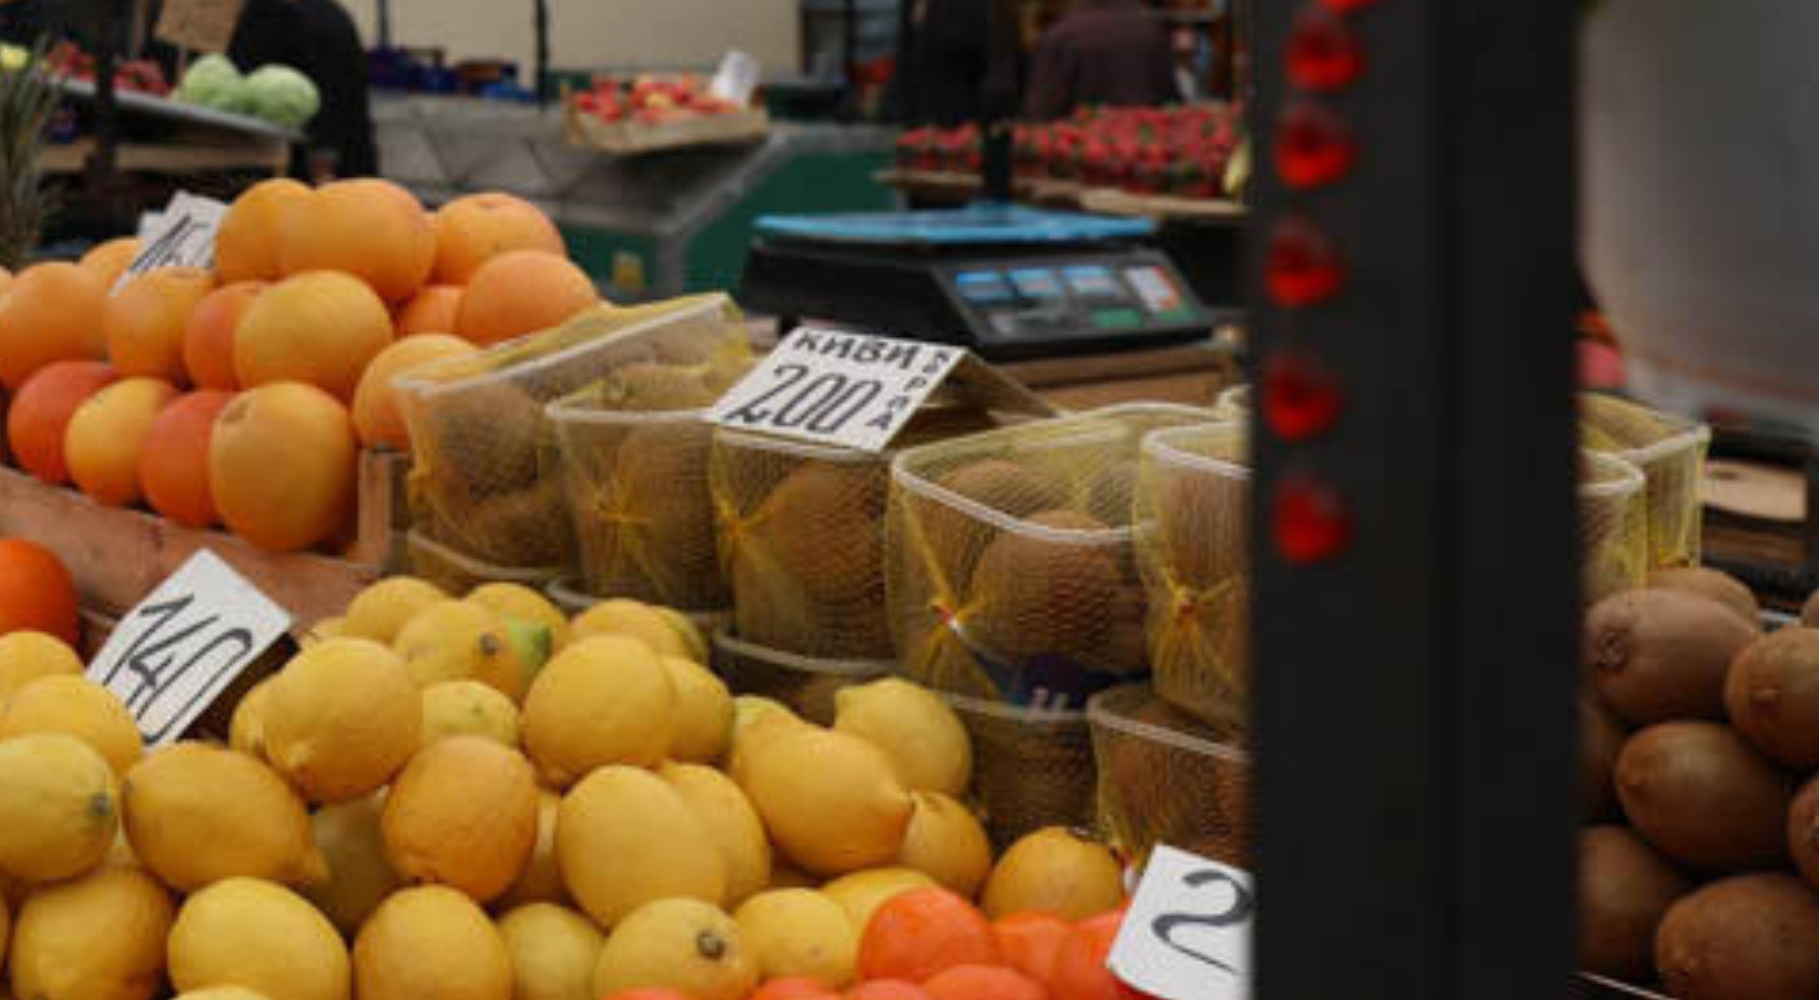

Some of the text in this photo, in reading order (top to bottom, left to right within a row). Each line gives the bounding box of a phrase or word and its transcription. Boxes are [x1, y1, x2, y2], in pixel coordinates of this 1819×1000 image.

[791, 329, 921, 370] КИВИ
[723, 364, 883, 434] 200
[101, 592, 253, 744] 140
